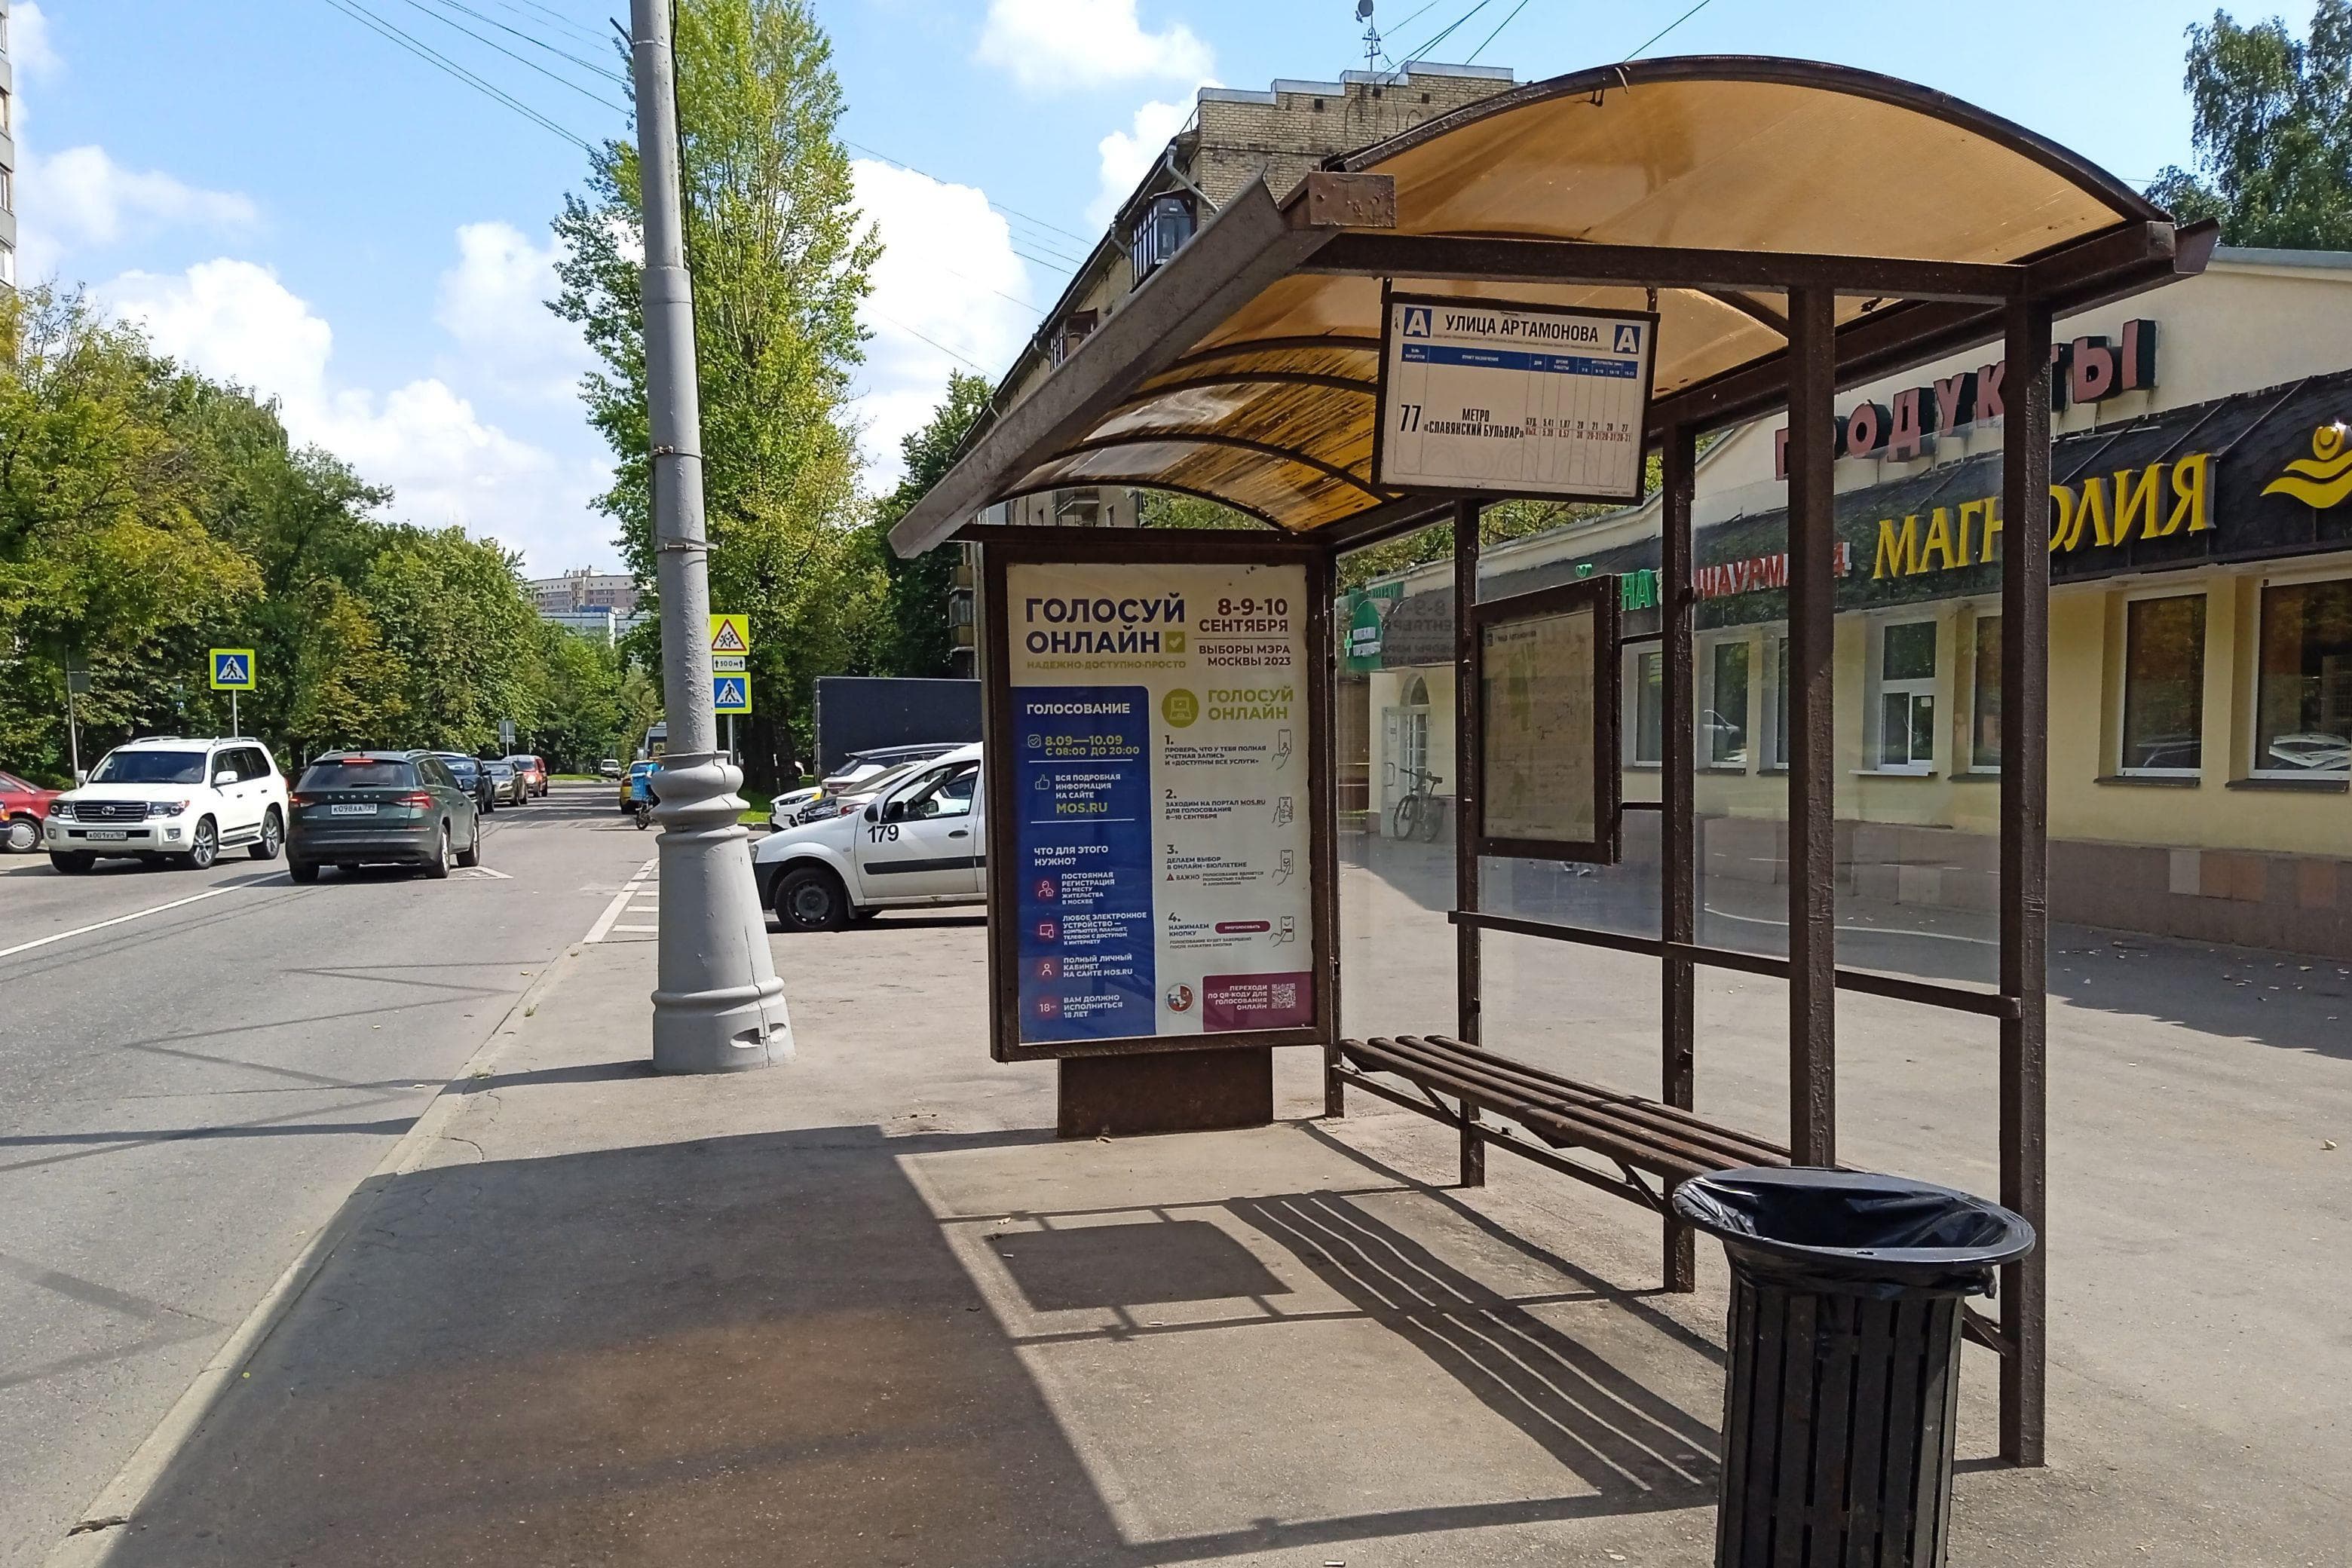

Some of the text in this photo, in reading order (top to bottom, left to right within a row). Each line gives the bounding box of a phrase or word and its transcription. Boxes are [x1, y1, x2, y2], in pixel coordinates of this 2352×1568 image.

[1446, 314, 1496, 335] УЛИЦА
[1500, 318, 1598, 342] АРТАМОНОВА
[1775, 319, 2156, 480] ОДУКЫ
[1400, 404, 1422, 432] 77
[1462, 408, 1490, 422] МЕТРО
[1424, 421, 1524, 439] «СЛАВЯНСКИЙ БУЛЬВАР»
[1696, 553, 1787, 600] ШАУРМ
[1026, 593, 1184, 623] ГОЛОСУЙ
[1217, 598, 1288, 617] 8-9-10
[1199, 619, 1288, 632] СЕНТЯБРЯ
[1026, 625, 1159, 654] ОНЛАЙН
[1199, 645, 1291, 654] ВЫБОРЫ МЭРА
[1208, 657, 1291, 666] МОСКВЫ 2023
[1208, 686, 1294, 703] ГОЛОСУЙ
[1027, 703, 1130, 715] ГОЛОСОВАНИЕ
[1208, 704, 1288, 721] ОНЛАЙН
[1165, 735, 1174, 745] 1.
[1055, 747, 1086, 756] 08:00
[1091, 747, 1107, 757] ДО
[1109, 746, 1140, 755] 20:00
[1069, 791, 1095, 799] САЙТЕ
[1165, 789, 1177, 799] 2.
[1056, 802, 1108, 813] MOS.RU
[867, 824, 899, 843] 179
[1055, 847, 1076, 856] ДЛЯ
[1078, 846, 1108, 854] ЭТОГО
[1167, 844, 1178, 854] 3.
[1034, 857, 1076, 866] НУЖНО?
[1061, 871, 1113, 880] ПОСТОЯННАЯ
[1063, 912, 1147, 922] ЛЮБОЕ ЭЛЕКТРОННОЕ
[1168, 912, 1181, 923] 4.
[1063, 920, 1113, 929] УСТРОЙСТВО
[1064, 953, 1132, 963] ПОЛНЫЙ ЛИЧНЫЙ
[1083, 994, 1120, 1003] ДОЛЖНО
[1064, 1002, 1123, 1011] ИСПОЛНИТЬСЯ
